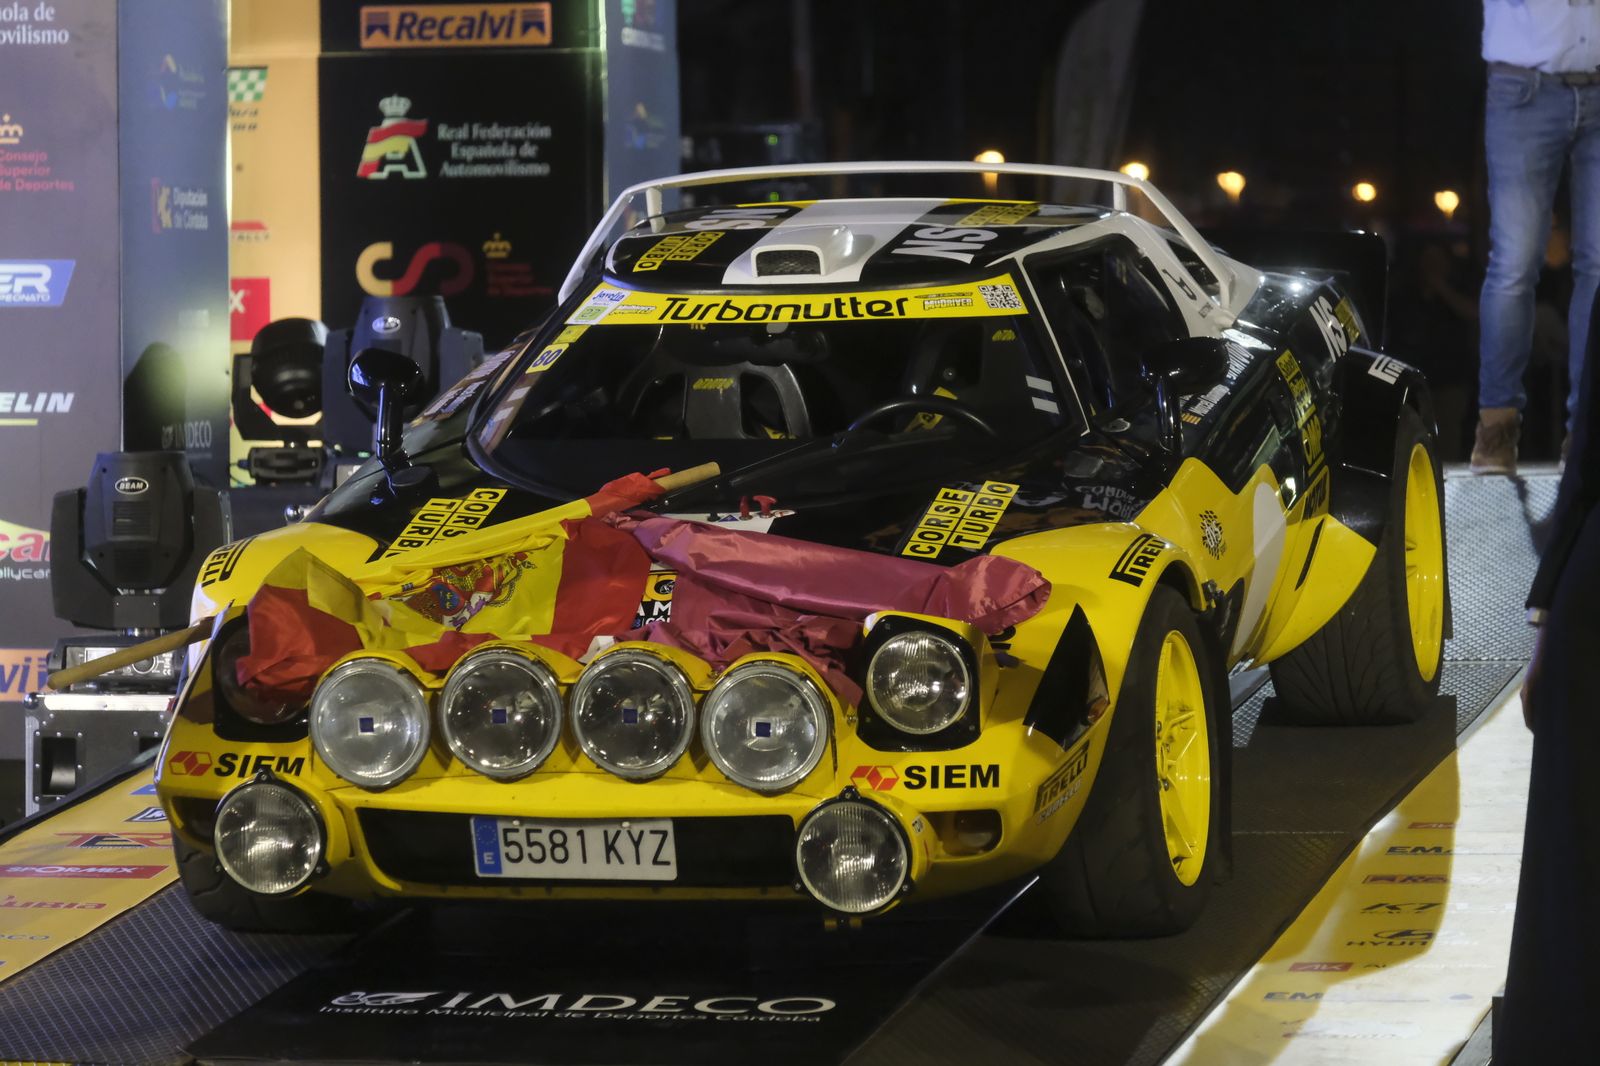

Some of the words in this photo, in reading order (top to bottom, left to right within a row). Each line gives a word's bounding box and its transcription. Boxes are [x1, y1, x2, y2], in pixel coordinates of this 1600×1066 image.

[0, 1, 29, 21] ola
[34, 1, 56, 21] de
[395, 9, 517, 41] Recalvi
[437, 123, 470, 140] Real
[657, 294, 909, 323] Turbonutter
[531, 348, 563, 368] 80
[119, 481, 144, 490] BEAM
[441, 489, 501, 541] CORS
[908, 490, 970, 556] CORSE
[951, 482, 1014, 547] TURBO
[214, 752, 305, 778] SIEM
[903, 763, 1000, 790] SIEM
[483, 852, 495, 865] E
[502, 827, 588, 865] 5581
[603, 829, 672, 866] KYZ
[319, 1006, 419, 1015] Instituto
[425, 1008, 549, 1018] Municipal
[593, 1011, 708, 1020] Deportes
[439, 992, 836, 1015] IMDECO
